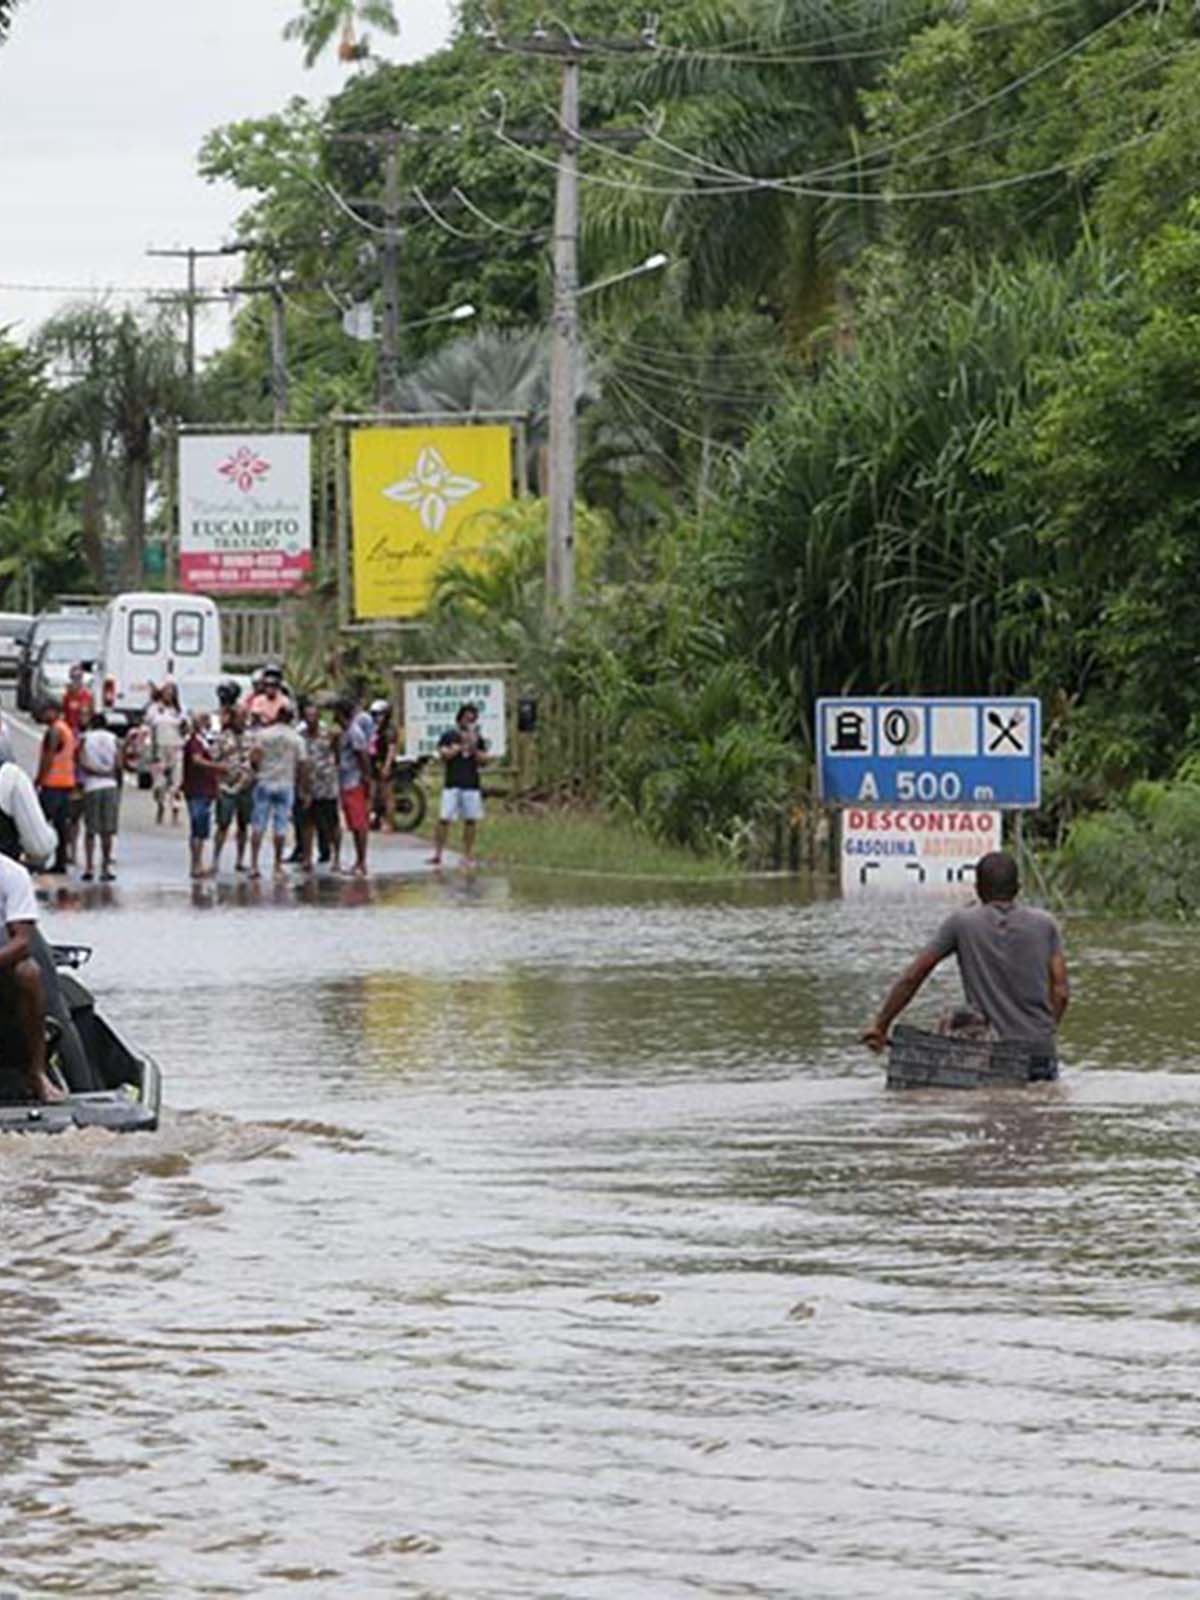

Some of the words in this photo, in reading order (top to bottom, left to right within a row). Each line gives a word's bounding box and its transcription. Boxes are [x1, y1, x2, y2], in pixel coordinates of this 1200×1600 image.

[191, 519, 300, 536] EUCALIPTO
[214, 538, 279, 549] TRATADO
[416, 684, 492, 698] EUCALIPTO
[425, 700, 487, 713] TRATO
[859, 772, 879, 799] A
[896, 771, 961, 800] 500
[973, 785, 994, 801] m
[846, 838, 917, 857] GASOLINA
